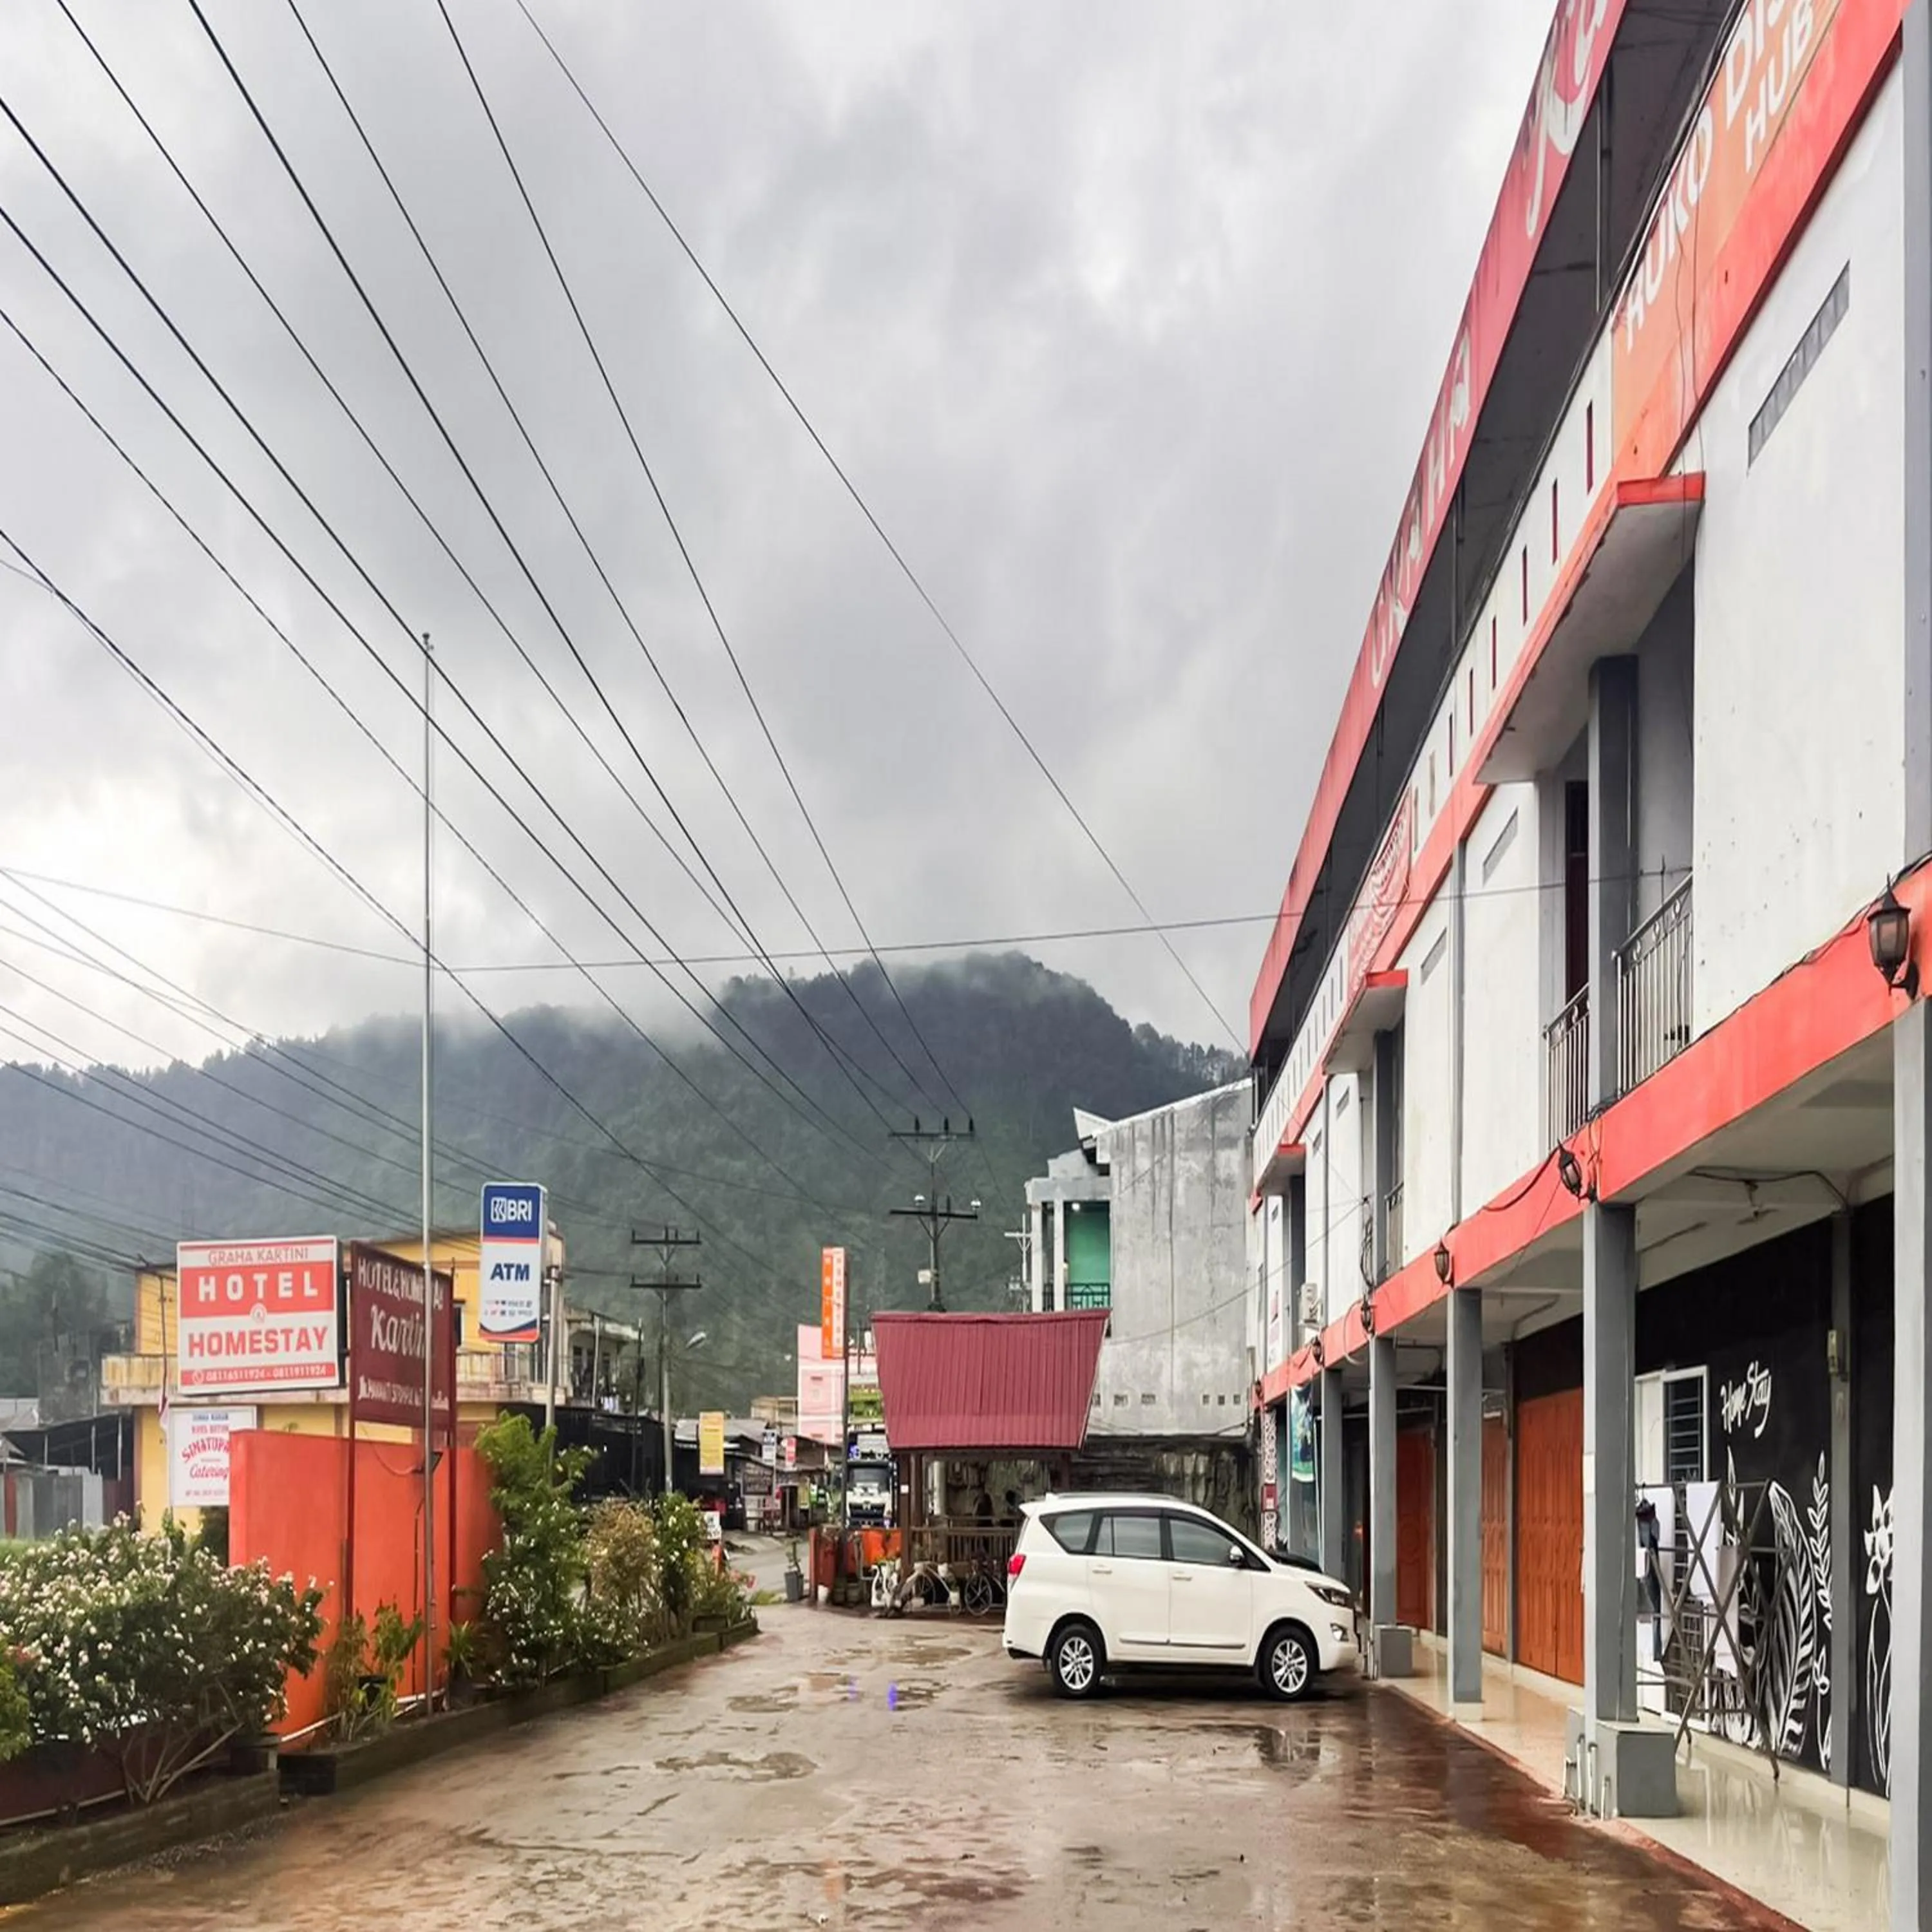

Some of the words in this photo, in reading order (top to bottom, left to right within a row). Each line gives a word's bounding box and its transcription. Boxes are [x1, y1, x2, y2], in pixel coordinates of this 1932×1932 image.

[507, 1199, 533, 1222] BRI
[207, 1249, 254, 1266] GRAHA
[257, 1247, 309, 1262] KARTINI
[198, 1271, 318, 1302] HOTEL
[358, 1257, 393, 1295] HOTEL
[490, 1263, 530, 1282] ATM
[188, 1326, 328, 1358] HOMESTAY
[370, 1303, 425, 1359] Kartin
[182, 1437, 231, 1463] SIMATUPA
